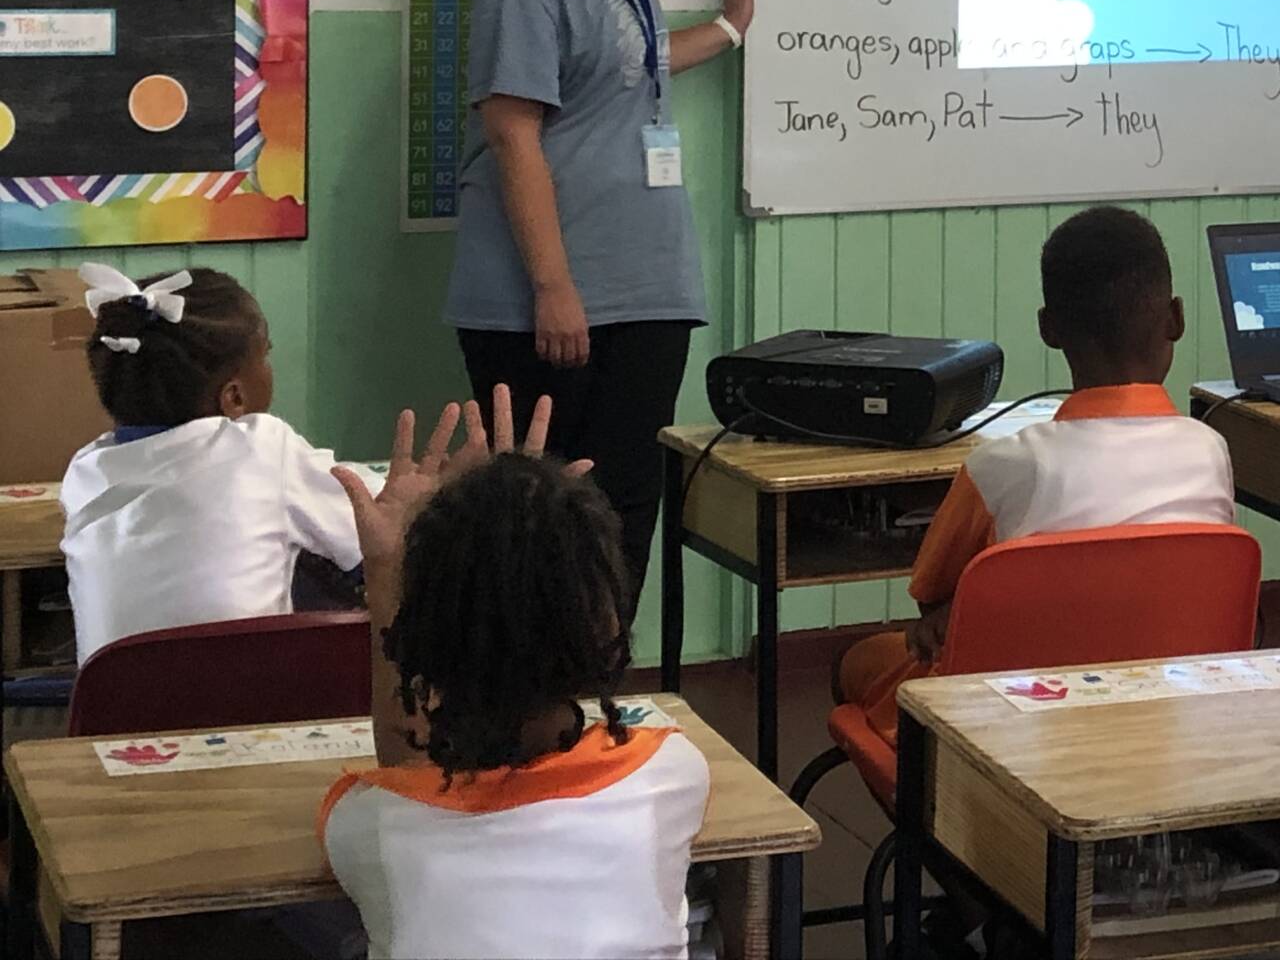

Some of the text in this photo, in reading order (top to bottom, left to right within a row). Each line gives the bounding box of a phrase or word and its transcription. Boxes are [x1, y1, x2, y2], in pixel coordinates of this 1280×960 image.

[438, 11, 454, 25] 22
[777, 30, 901, 80] oranges,
[775, 89, 1164, 168] Jane, Sam, Pat they
[436, 172, 453, 186] 82
[436, 198, 453, 212] 92
